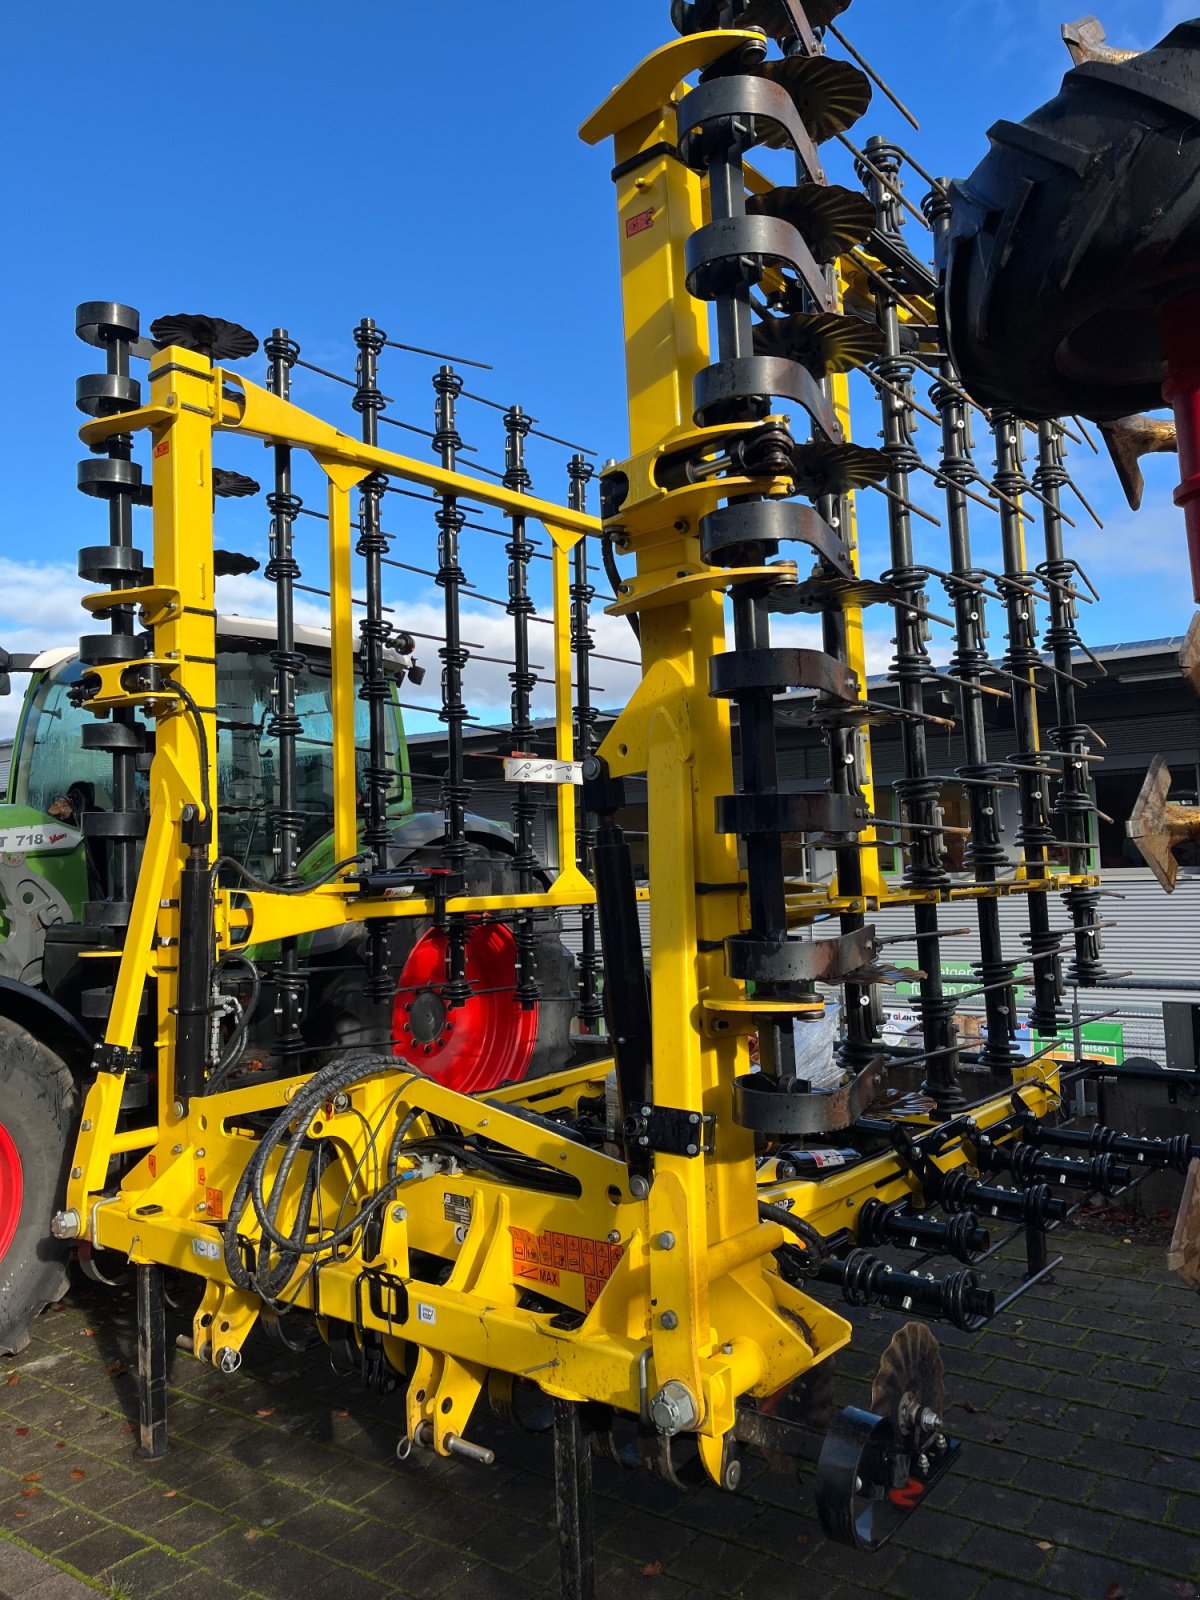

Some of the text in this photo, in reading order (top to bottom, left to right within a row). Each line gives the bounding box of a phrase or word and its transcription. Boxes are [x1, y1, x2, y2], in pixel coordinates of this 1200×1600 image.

[16, 834, 44, 846] 718
[941, 985, 957, 997] en
[540, 1268, 558, 1285] MAX
